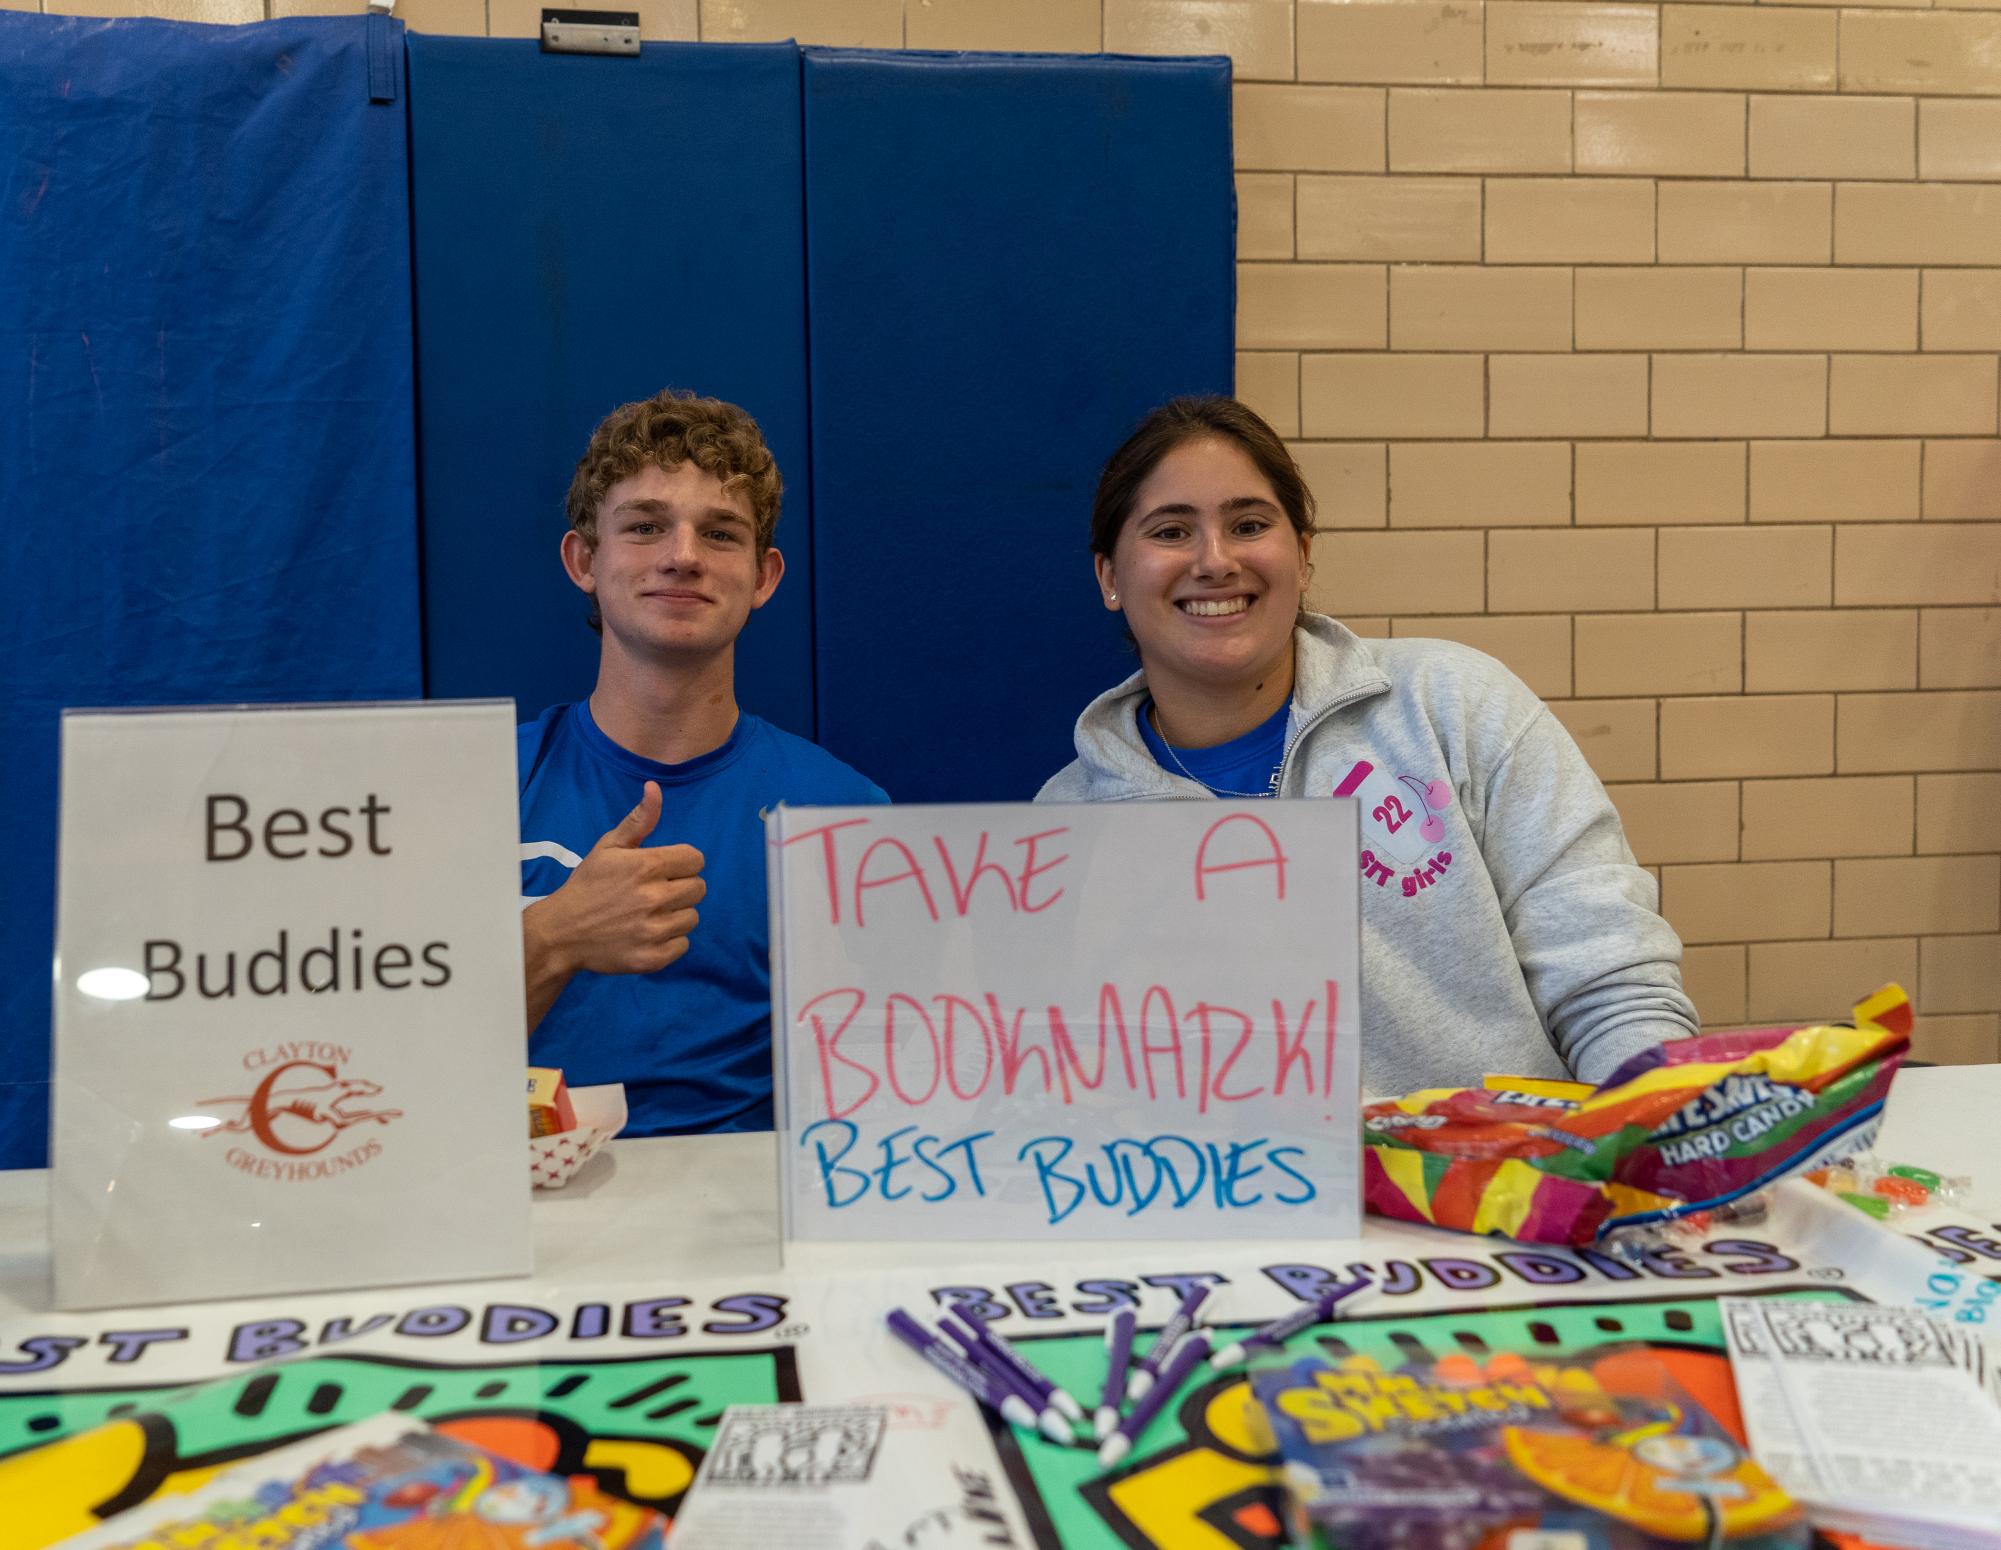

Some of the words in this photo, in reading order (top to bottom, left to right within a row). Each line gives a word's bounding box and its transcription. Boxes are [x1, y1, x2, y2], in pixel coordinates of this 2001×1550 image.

[205, 793, 392, 863] Best
[1372, 795, 1413, 834] 22
[772, 817, 1071, 927] TAKE
[1195, 813, 1289, 902] A
[1402, 851, 1452, 897] girls
[142, 927, 452, 1002] Buddies
[243, 1041, 352, 1071] CLAYTON
[797, 980, 1339, 1121] BOOKMARK!
[225, 1139, 383, 1181] GREYHOUNDS
[1659, 1130, 1730, 1166] HARD
[1733, 1090, 1816, 1143] CANDY
[801, 1119, 994, 1208] BEST
[1019, 1135, 1317, 1224] BUDDIES
[0, 1327, 189, 1375] ST
